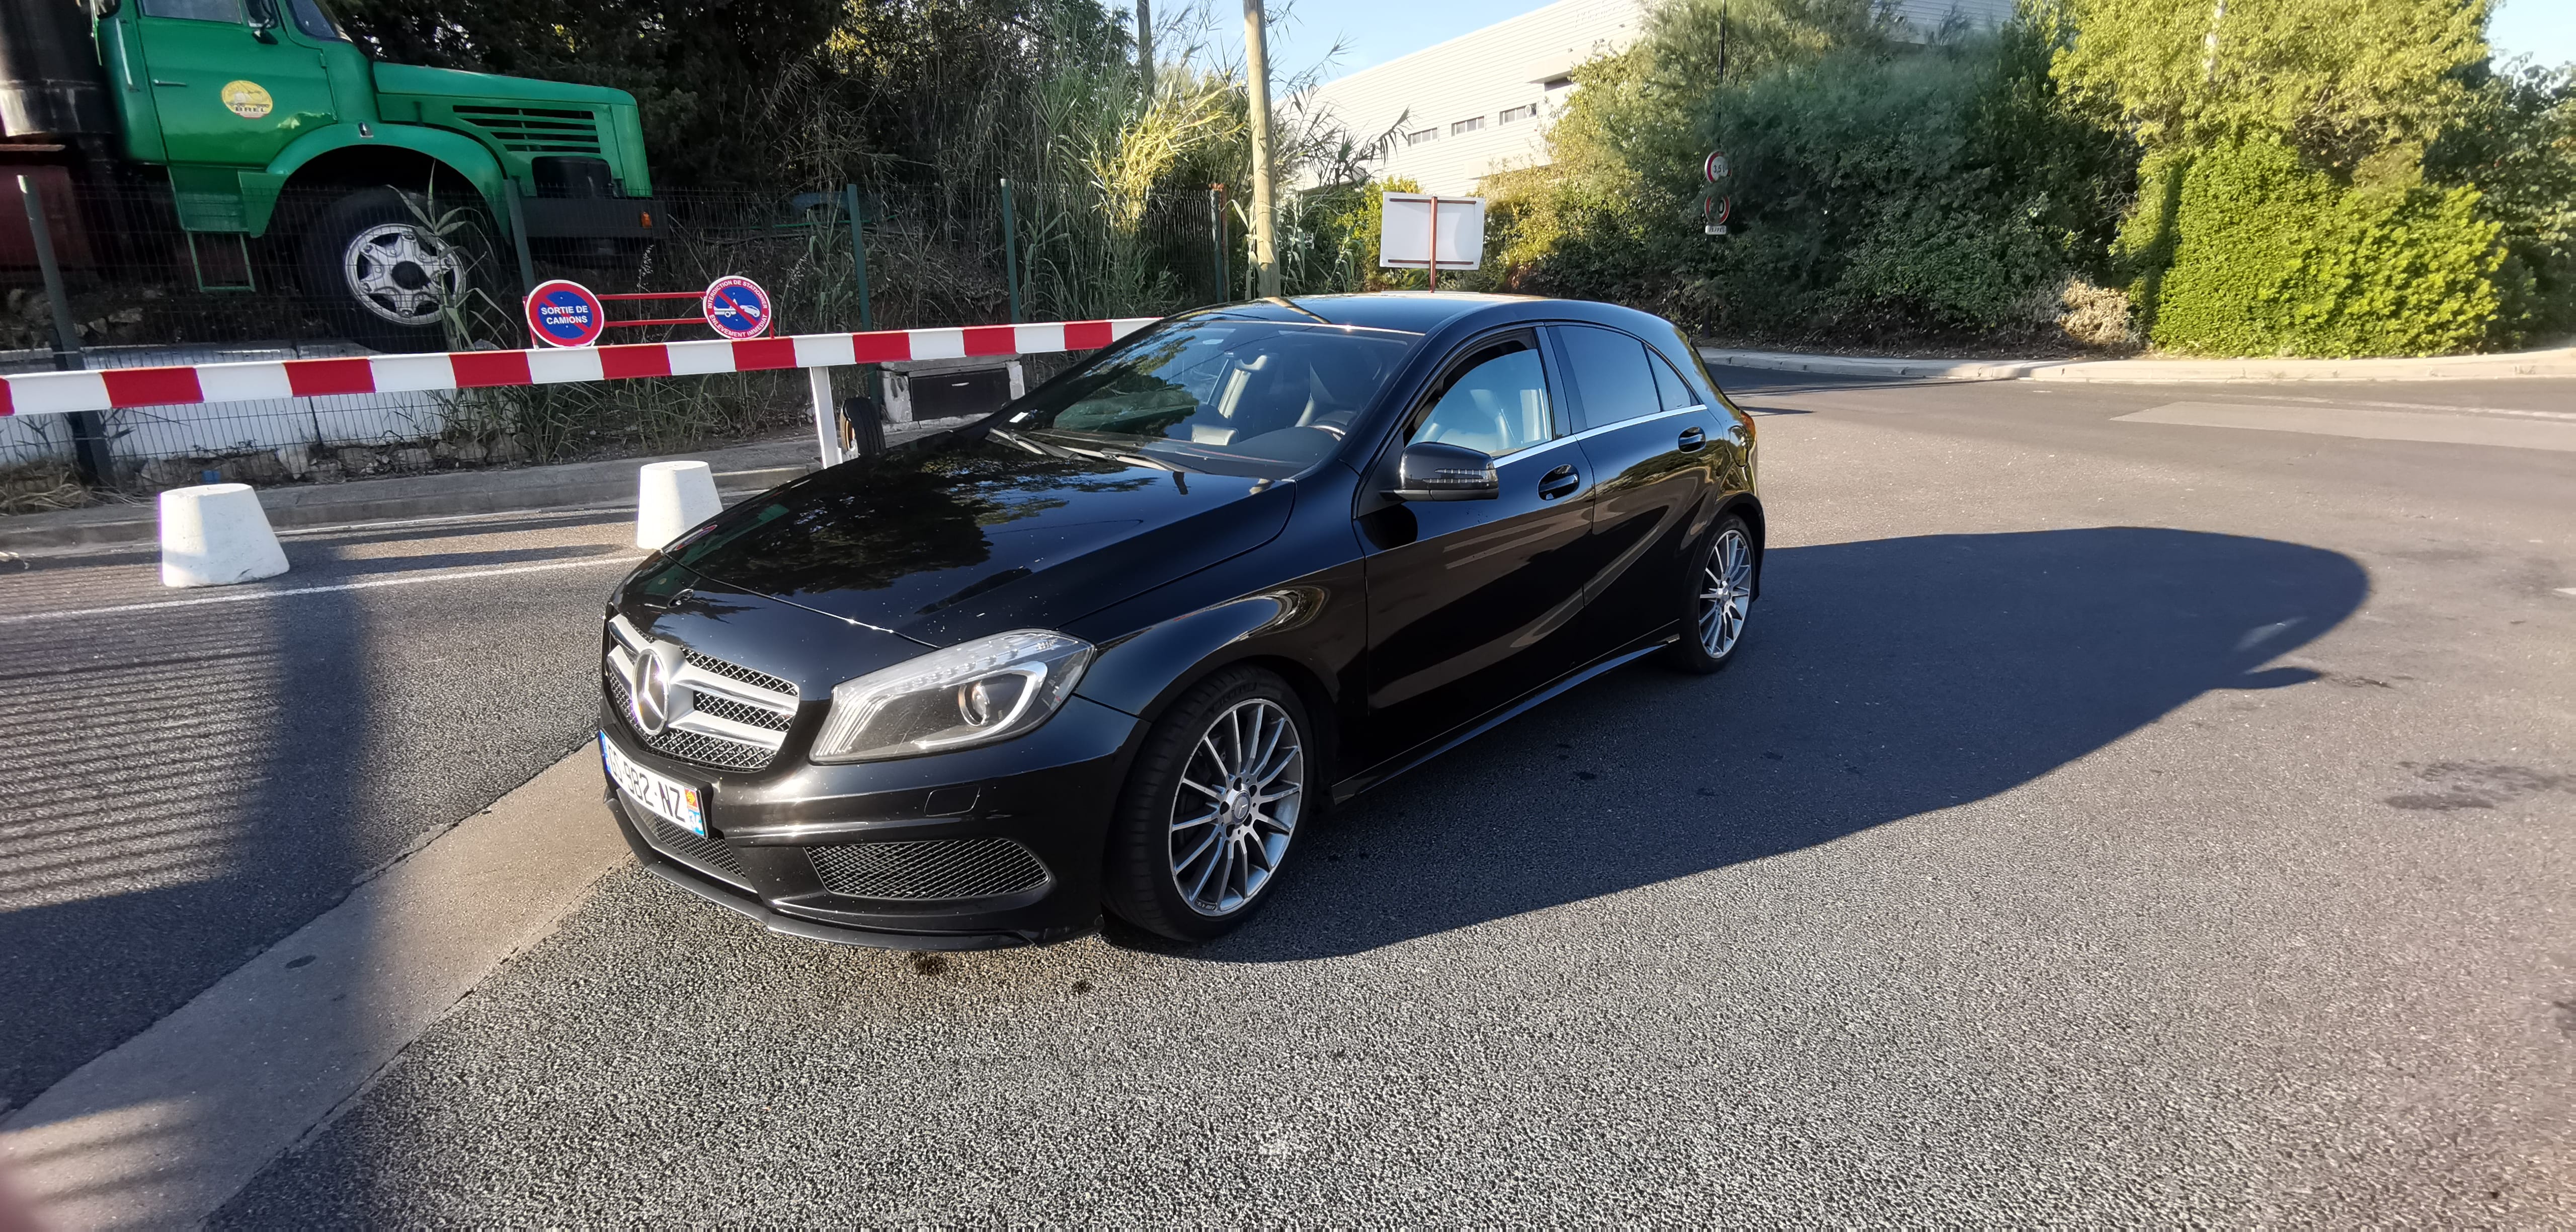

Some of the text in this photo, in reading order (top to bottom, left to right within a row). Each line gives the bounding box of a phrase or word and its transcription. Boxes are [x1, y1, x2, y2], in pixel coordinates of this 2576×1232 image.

[707, 280, 733, 309] INTERDICTION
[743, 281, 768, 309] STATIONNER
[541, 305, 589, 315] SORTIE DE
[546, 316, 588, 325] CAMIONS
[709, 314, 768, 337] ENLEVEMENT IMMEDIAT
